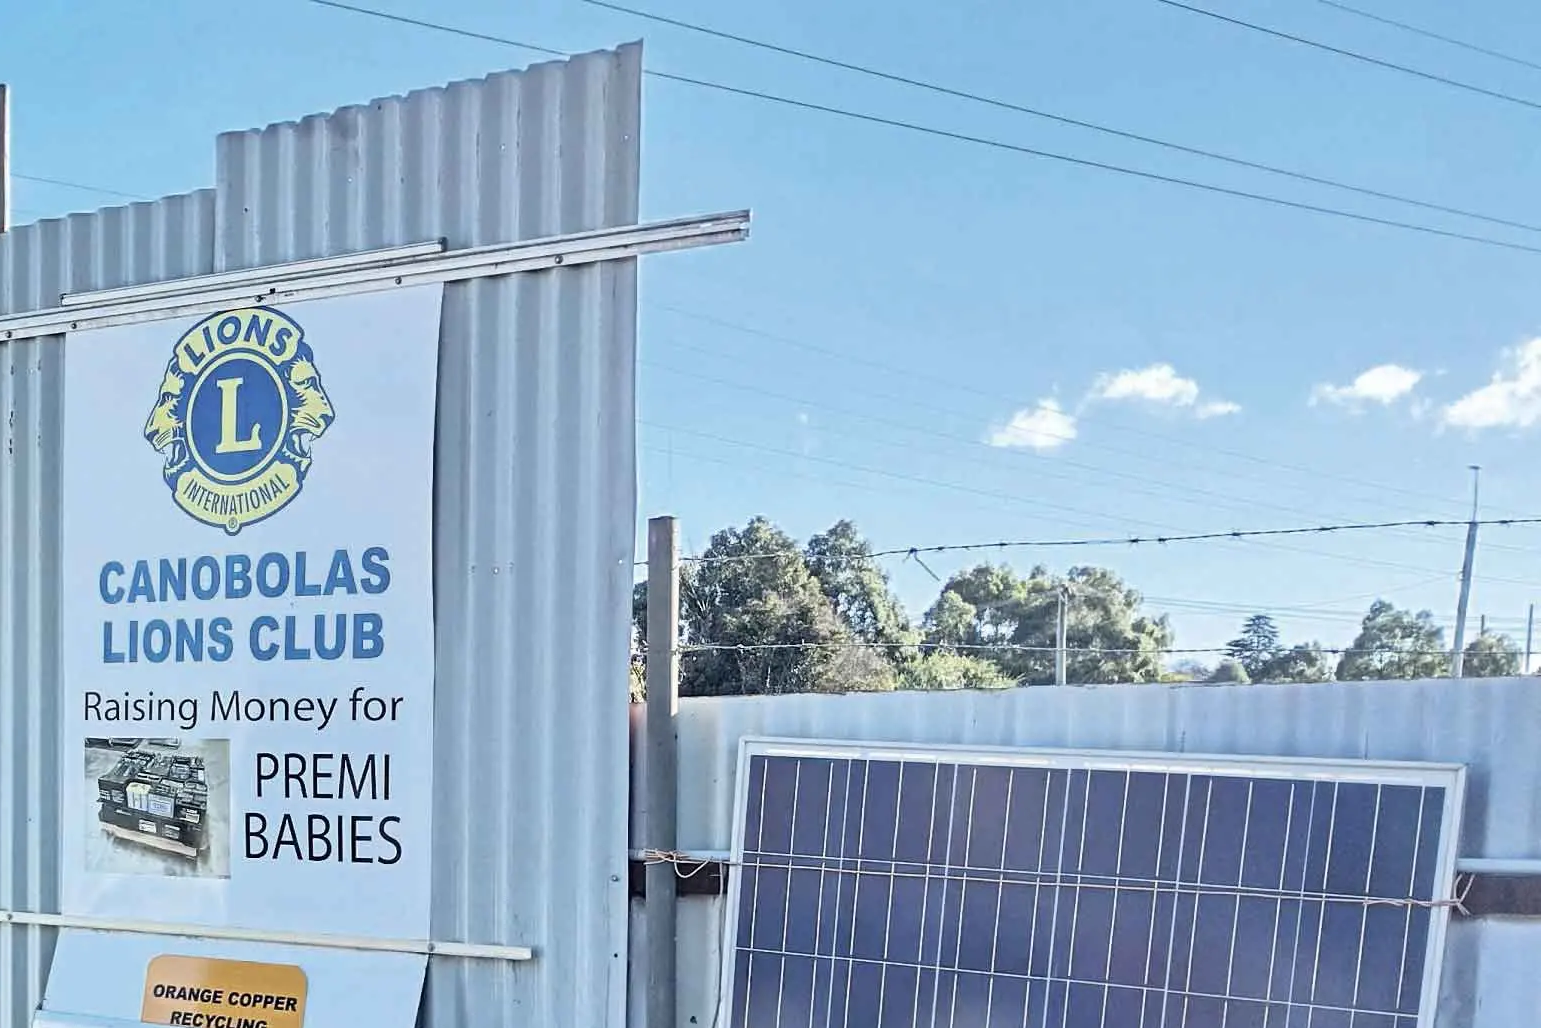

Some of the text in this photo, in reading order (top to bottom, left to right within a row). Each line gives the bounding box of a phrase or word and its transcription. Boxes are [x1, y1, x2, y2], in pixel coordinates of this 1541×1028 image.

[183, 314, 293, 368] LIONS
[215, 377, 262, 454] L
[183, 473, 290, 515] INTERNATIONAL
[99, 546, 391, 604] CANOBOLAS
[103, 612, 385, 664] LIONS CLUB
[84, 686, 404, 731] Raising Money for
[256, 752, 390, 800] PREMI
[244, 812, 402, 865] BABIES
[153, 984, 297, 1012] ORANGE COPPER
